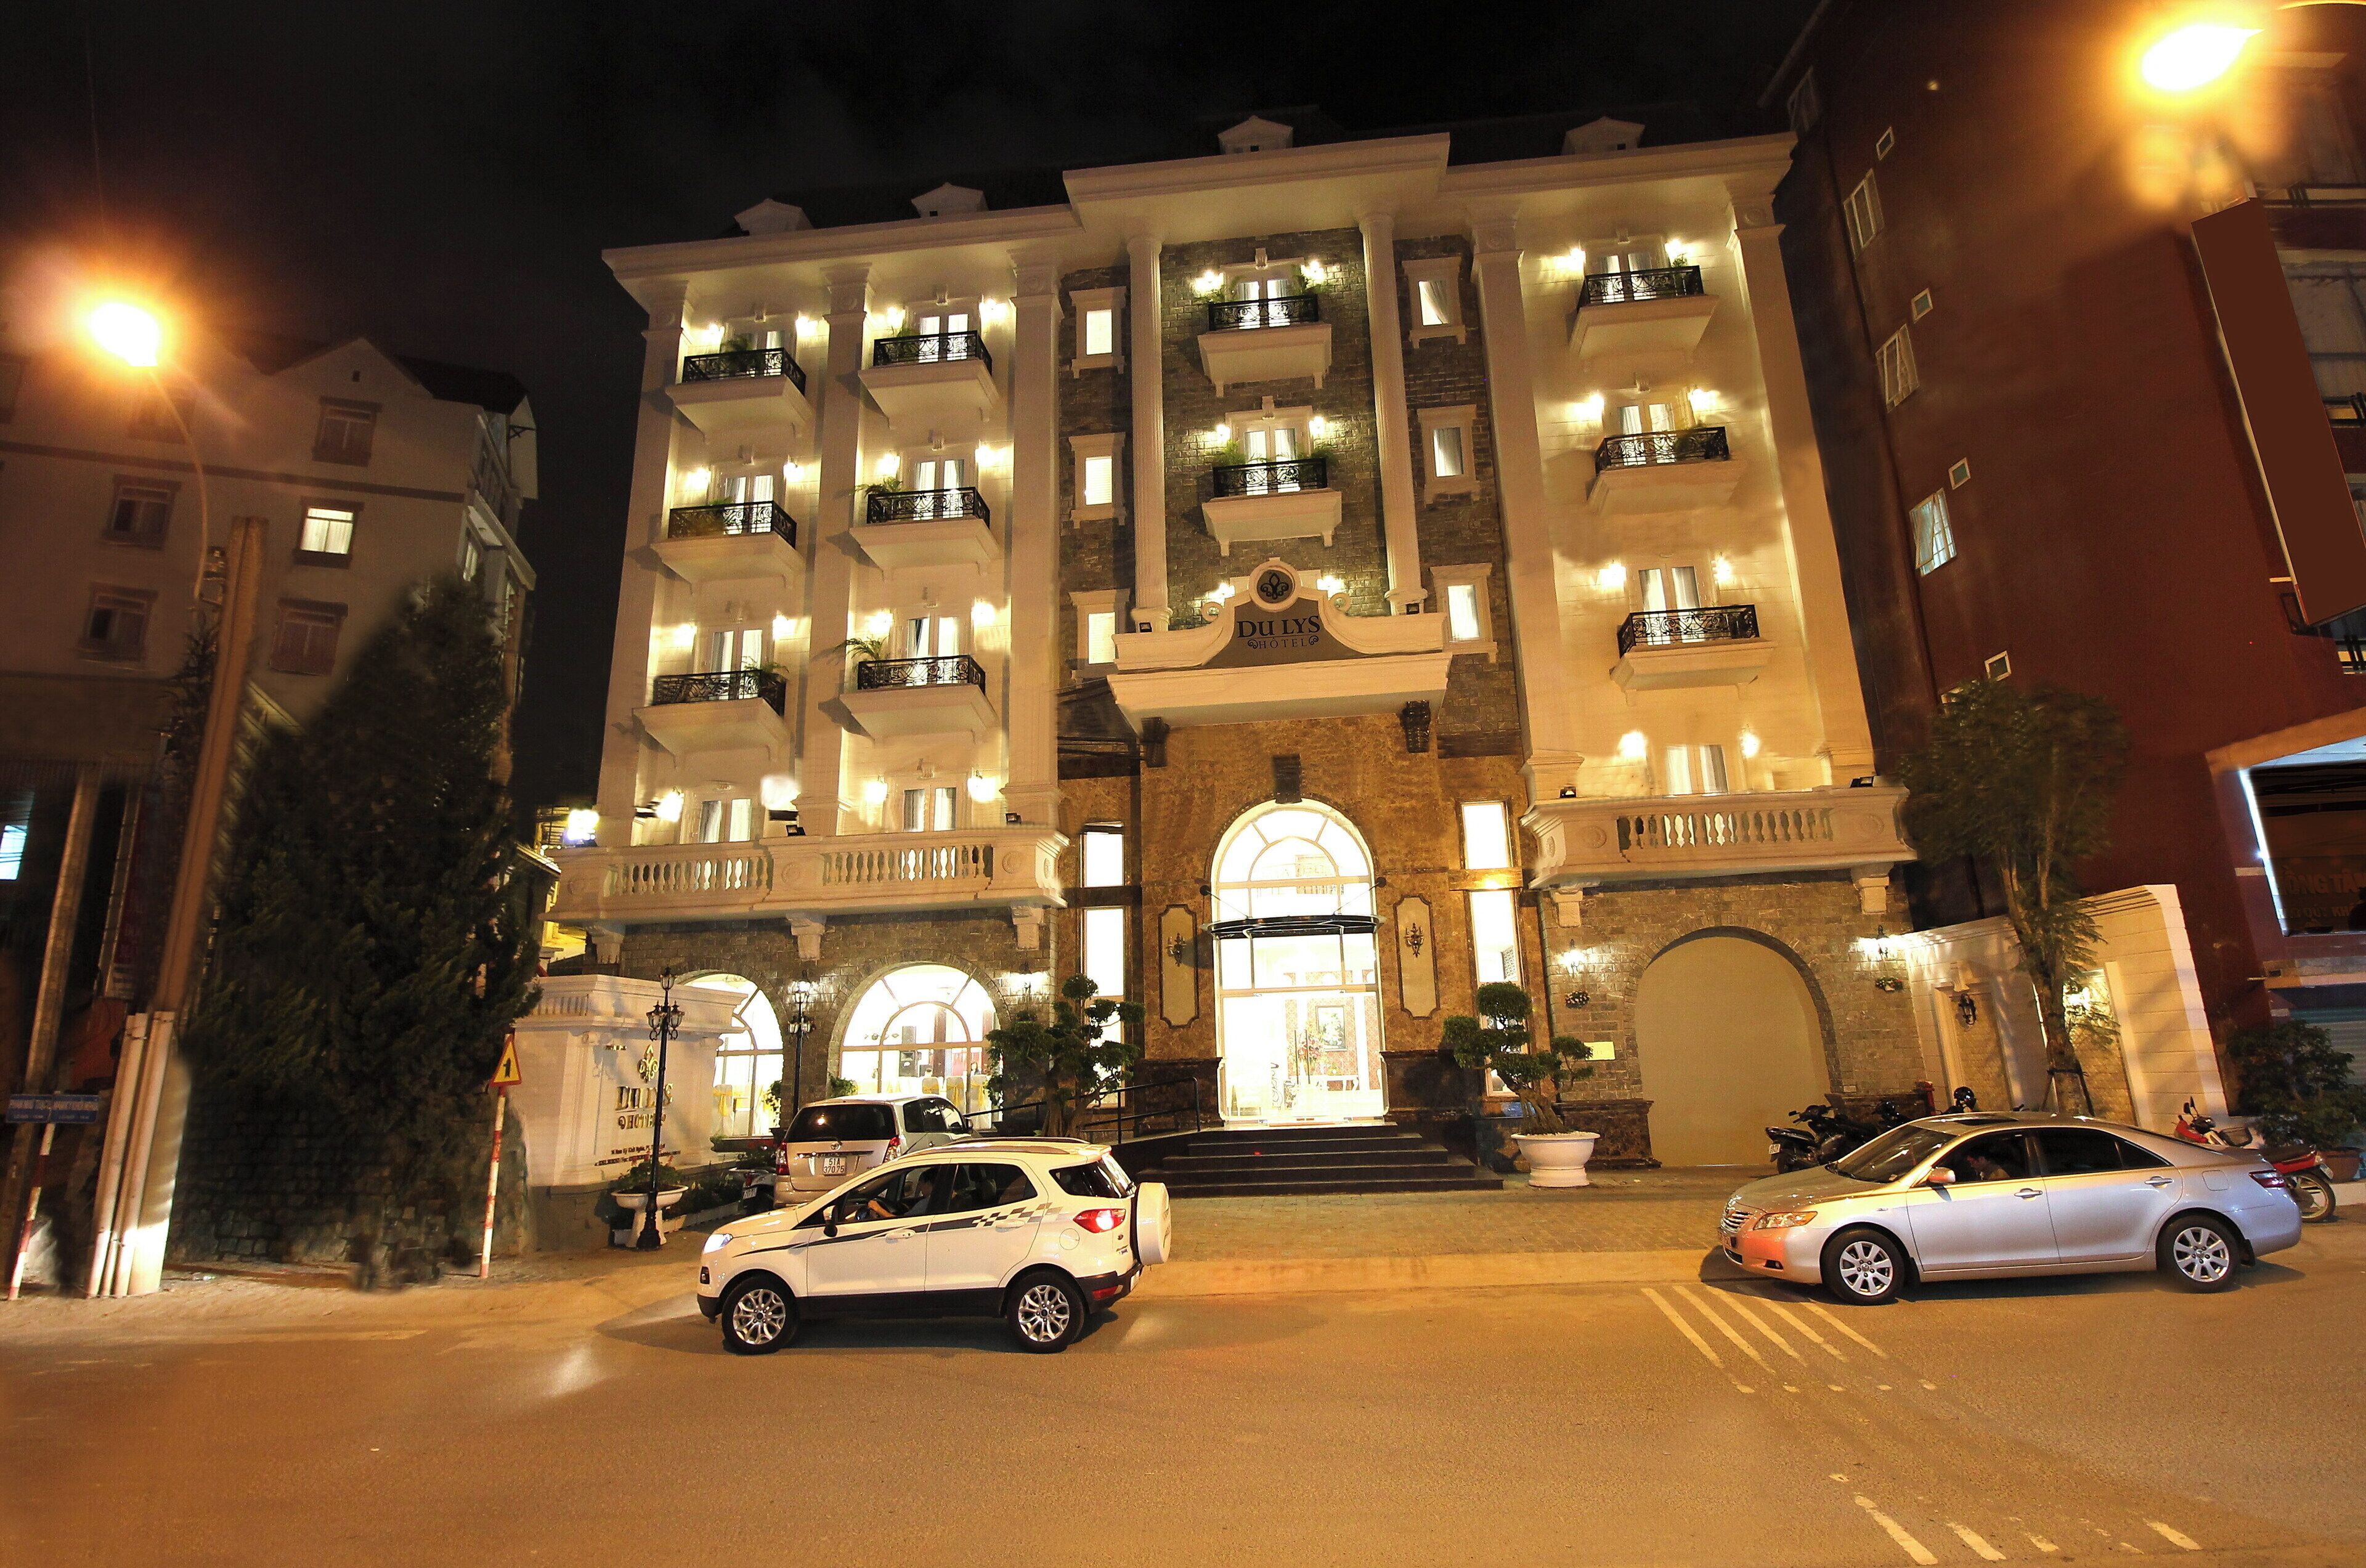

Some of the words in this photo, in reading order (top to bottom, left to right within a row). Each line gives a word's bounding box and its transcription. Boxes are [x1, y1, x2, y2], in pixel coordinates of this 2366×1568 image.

[1237, 620, 1275, 638] DU
[1282, 615, 1320, 635] LYS
[1259, 637, 1307, 649] HÔTEL
